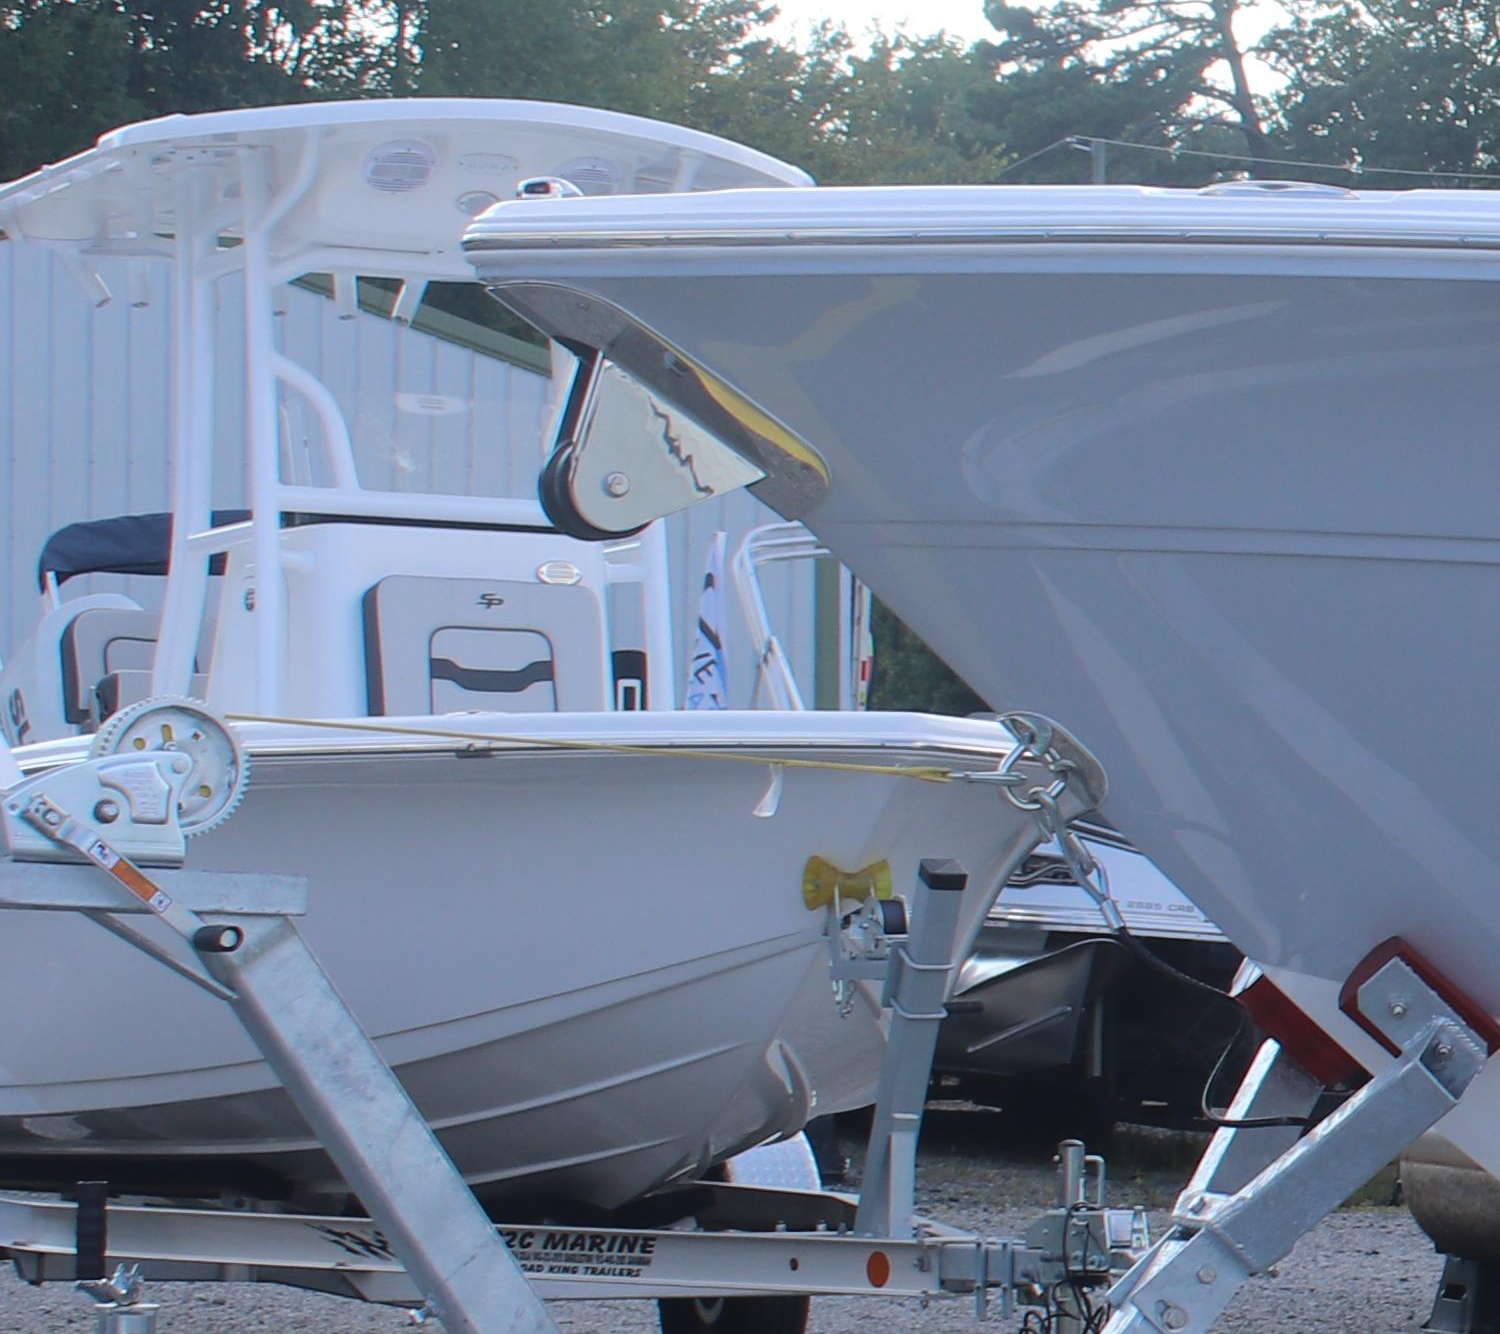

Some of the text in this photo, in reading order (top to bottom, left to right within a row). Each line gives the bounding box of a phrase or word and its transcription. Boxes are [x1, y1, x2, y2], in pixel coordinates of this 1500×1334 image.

[502, 1230, 658, 1255] 2C MARINE
[548, 1264, 580, 1276] KING
[582, 1265, 643, 1279] TRAILERS
